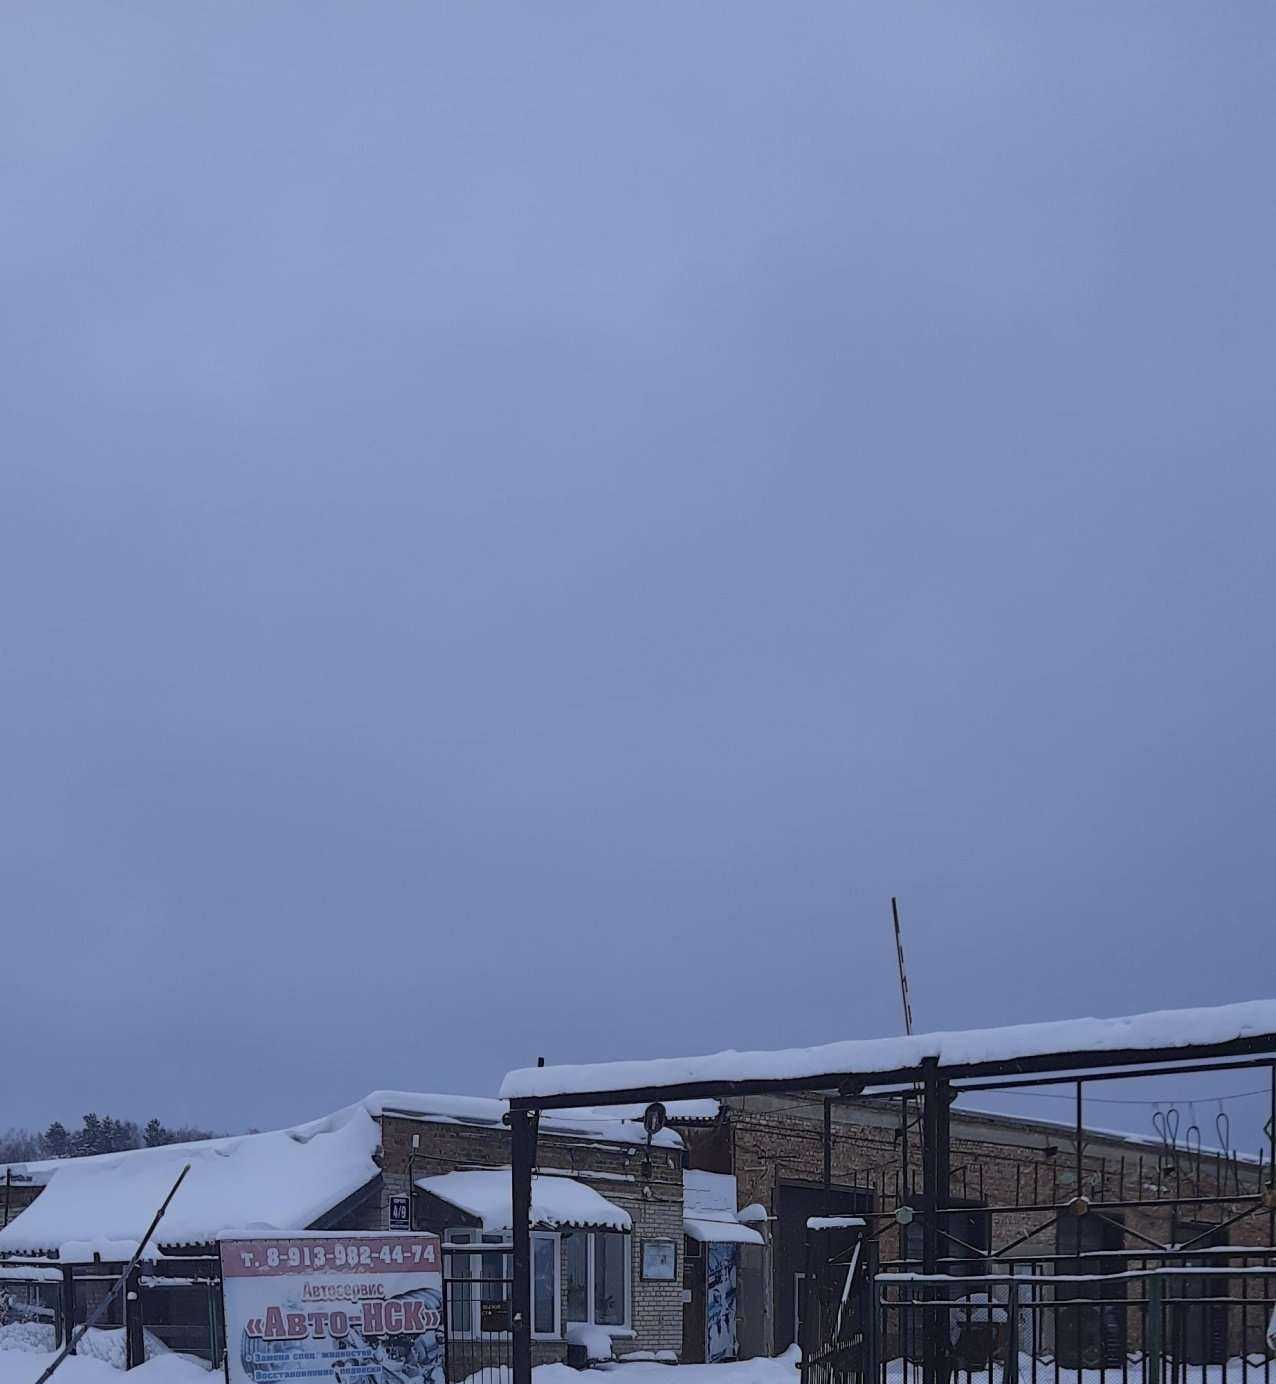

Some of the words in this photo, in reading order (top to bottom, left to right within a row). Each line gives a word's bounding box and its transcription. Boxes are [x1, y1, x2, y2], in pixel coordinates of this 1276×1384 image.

[241, 1252, 260, 1267] т.
[266, 1244, 435, 1267] 8-913-982-44-74
[303, 1282, 385, 1301] Автосервис
[246, 1300, 440, 1338] «Авто-НСК»
[255, 1353, 290, 1362] Замена
